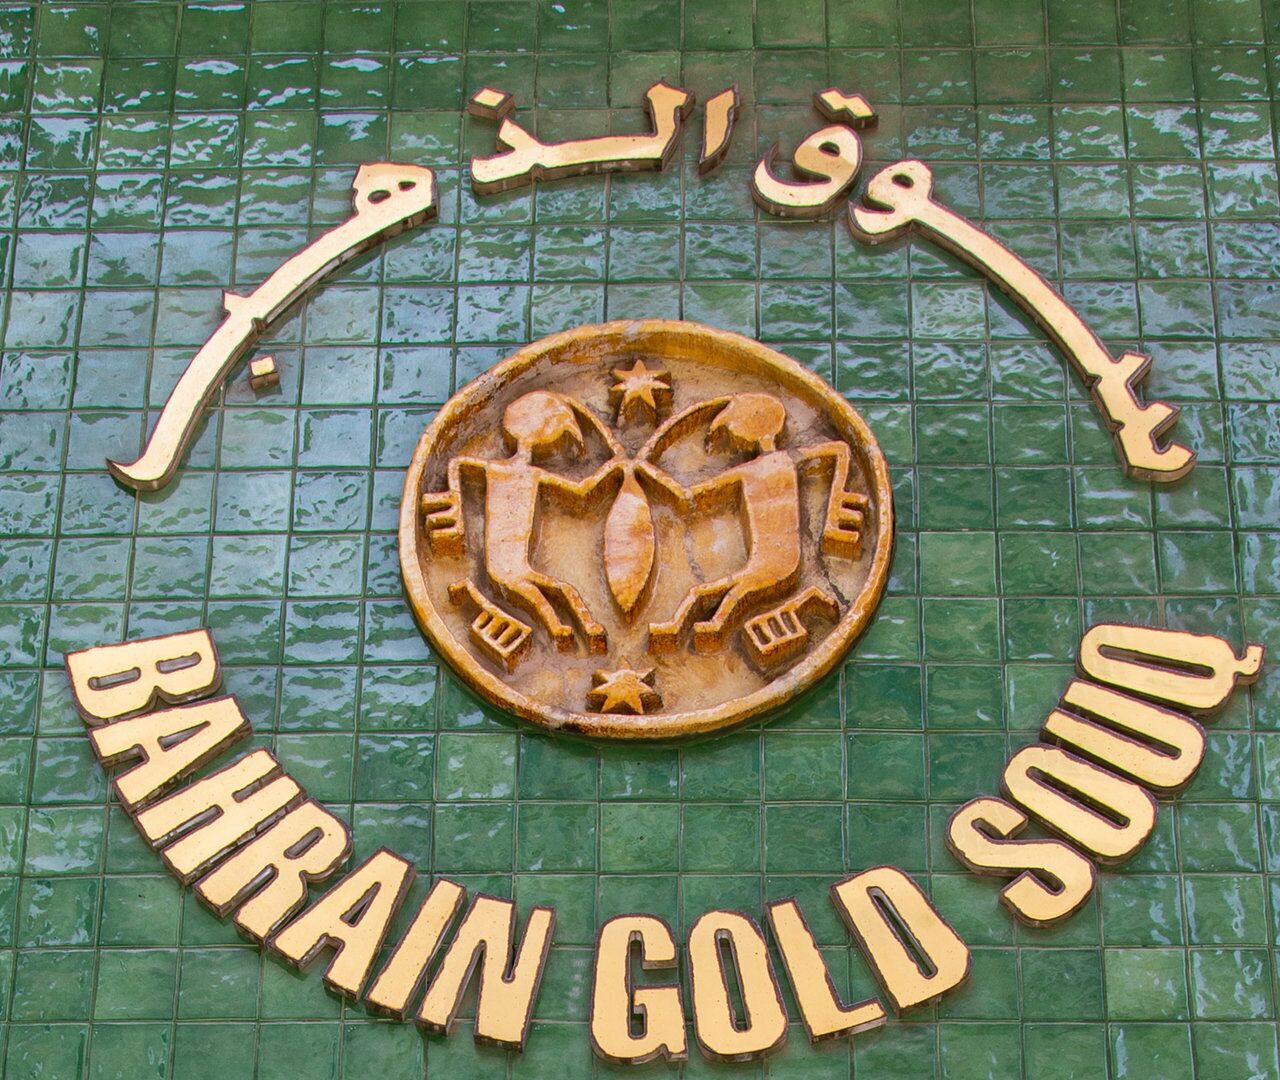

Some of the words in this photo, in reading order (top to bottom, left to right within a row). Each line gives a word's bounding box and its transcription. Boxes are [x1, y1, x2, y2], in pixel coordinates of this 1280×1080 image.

[106, 81, 741, 492] الذهب
[751, 86, 1197, 483] سوق
[63, 626, 555, 1052] BAHRAIN
[589, 864, 973, 1062] GOLD
[944, 623, 1264, 928] SOUQ
